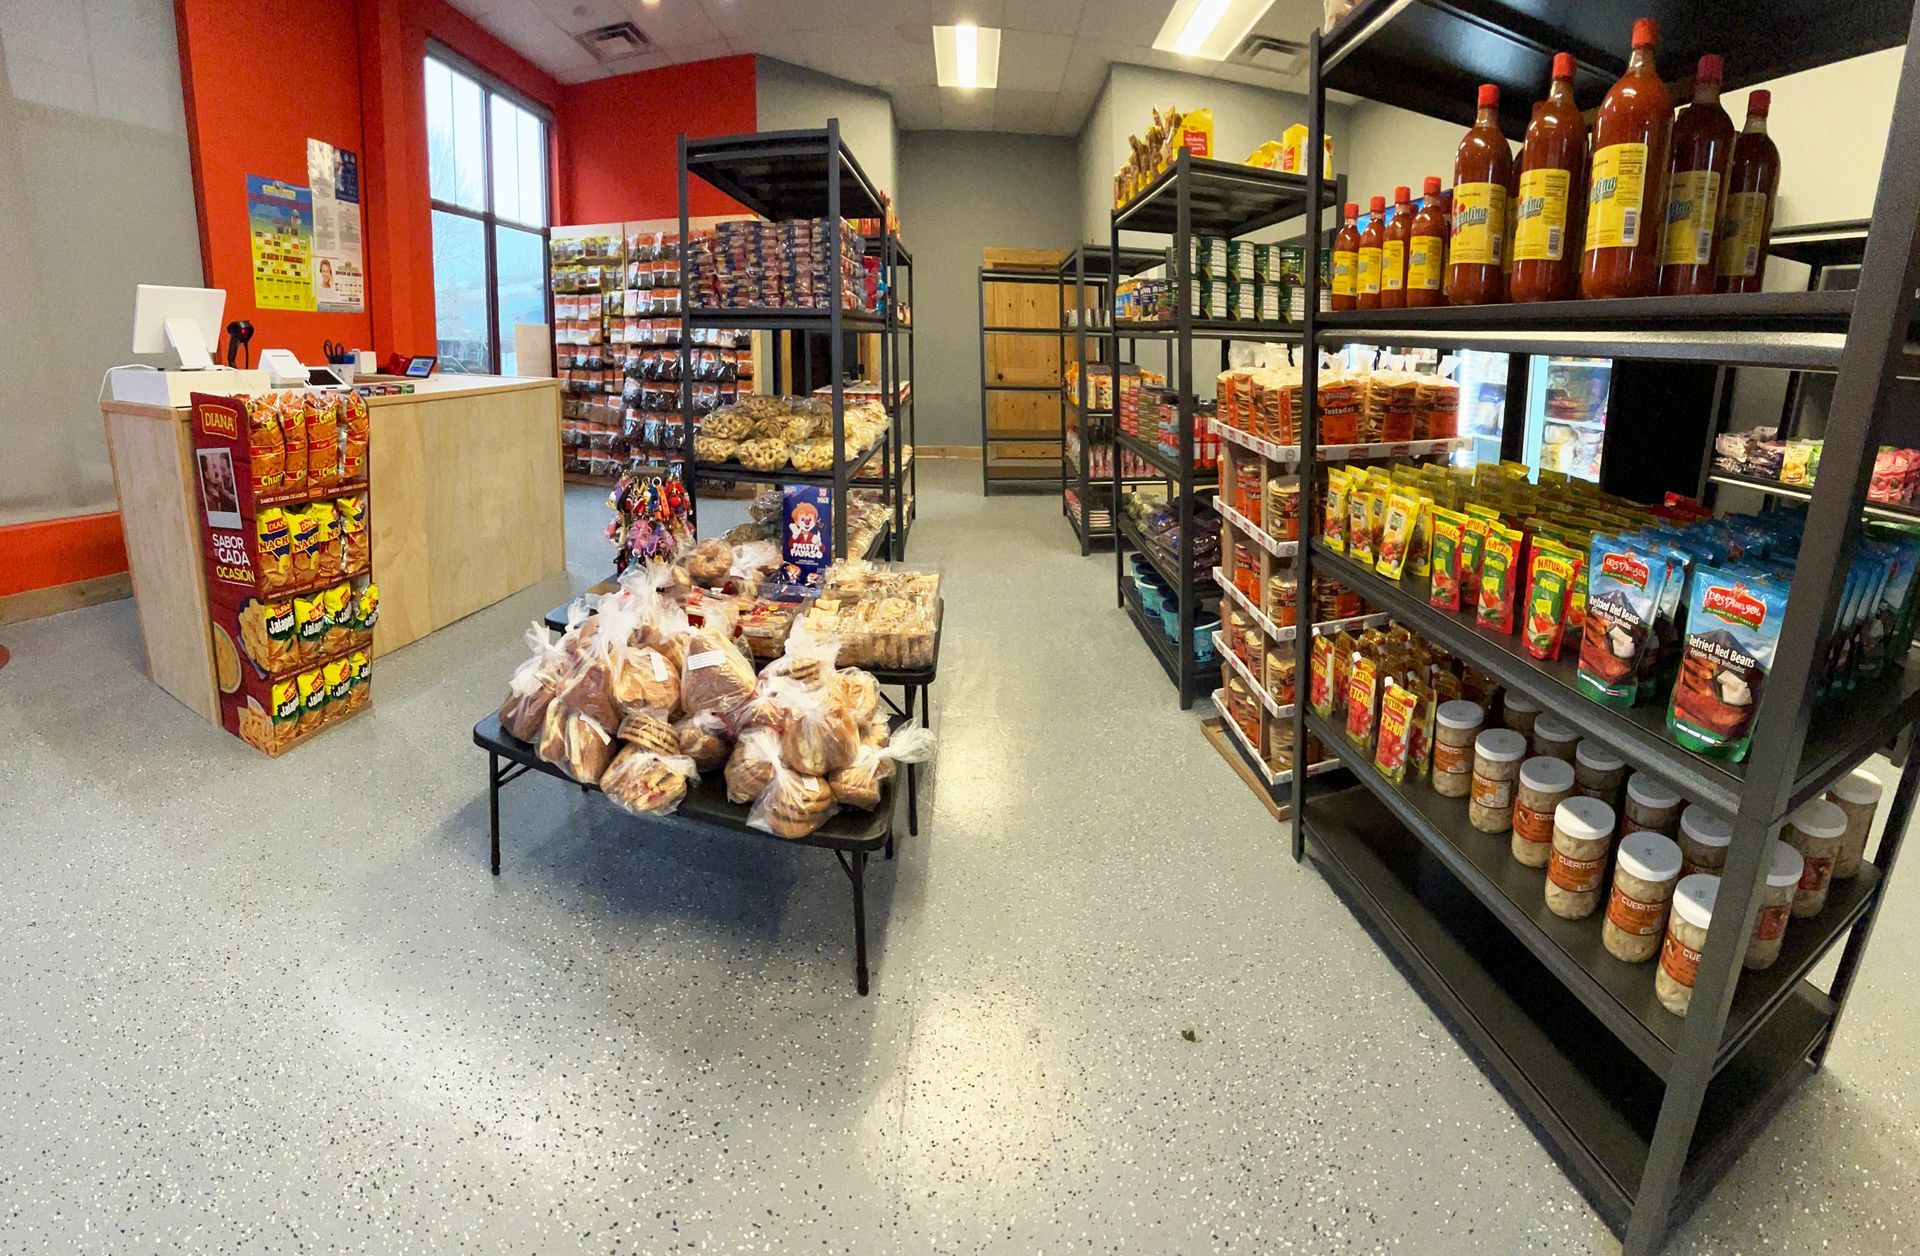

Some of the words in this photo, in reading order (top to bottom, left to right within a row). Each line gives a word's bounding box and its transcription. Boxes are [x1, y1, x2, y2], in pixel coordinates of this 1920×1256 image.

[1324, 406, 1354, 415] Tostadas
[204, 411, 235, 432] DIANA
[212, 533, 245, 550] SABOR
[218, 547, 251, 567] CADA
[216, 565, 255, 583] OCASIÓN
[1610, 602, 1622, 616] Red
[1620, 607, 1640, 625] Beans
[1714, 642, 1730, 660] Red
[1729, 650, 1756, 668] Beans
[1558, 855, 1598, 870] CUERITOS
[1621, 895, 1665, 913] CUERITOS
[1682, 948, 1702, 963] CUE
